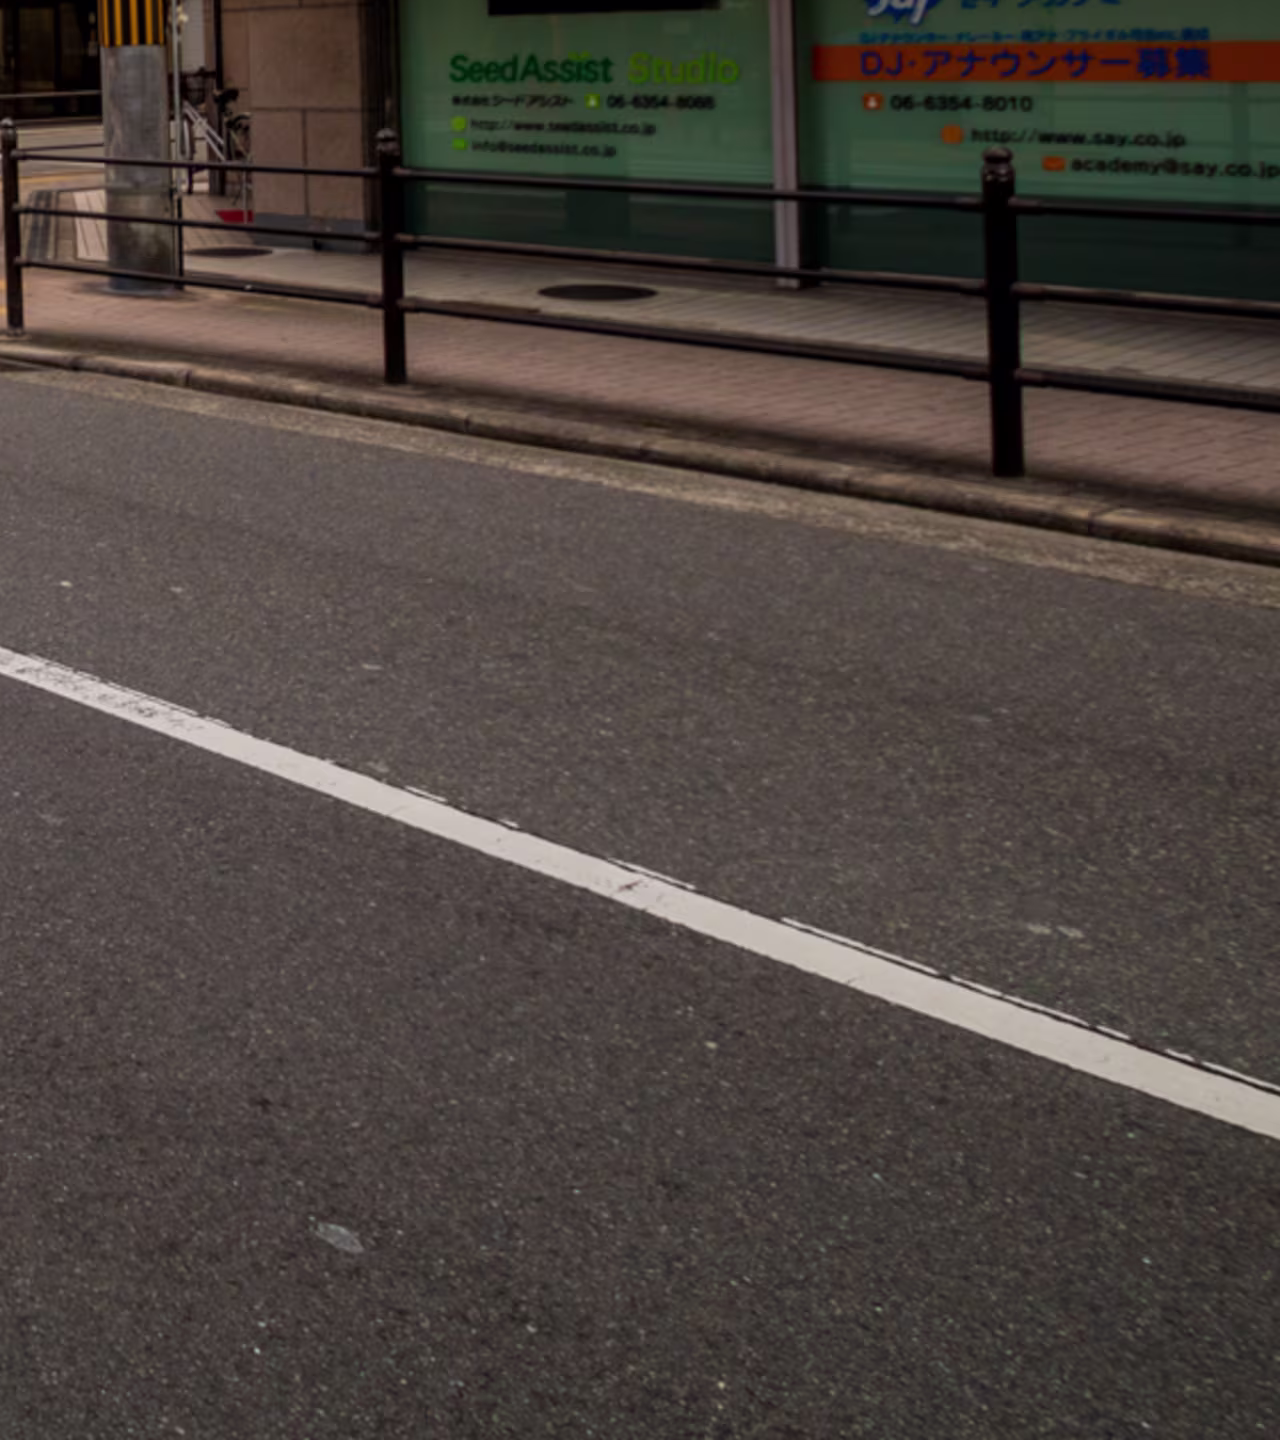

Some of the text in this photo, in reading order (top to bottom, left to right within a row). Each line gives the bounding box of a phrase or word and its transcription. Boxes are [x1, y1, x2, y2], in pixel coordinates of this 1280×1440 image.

[449, 50, 740, 85] SeedAssist Studio
[890, 94, 1034, 113] 06-6354-8010
[970, 127, 1186, 149] http://www.say.co.jp
[1070, 157, 1280, 179] academy@say.co.jp
